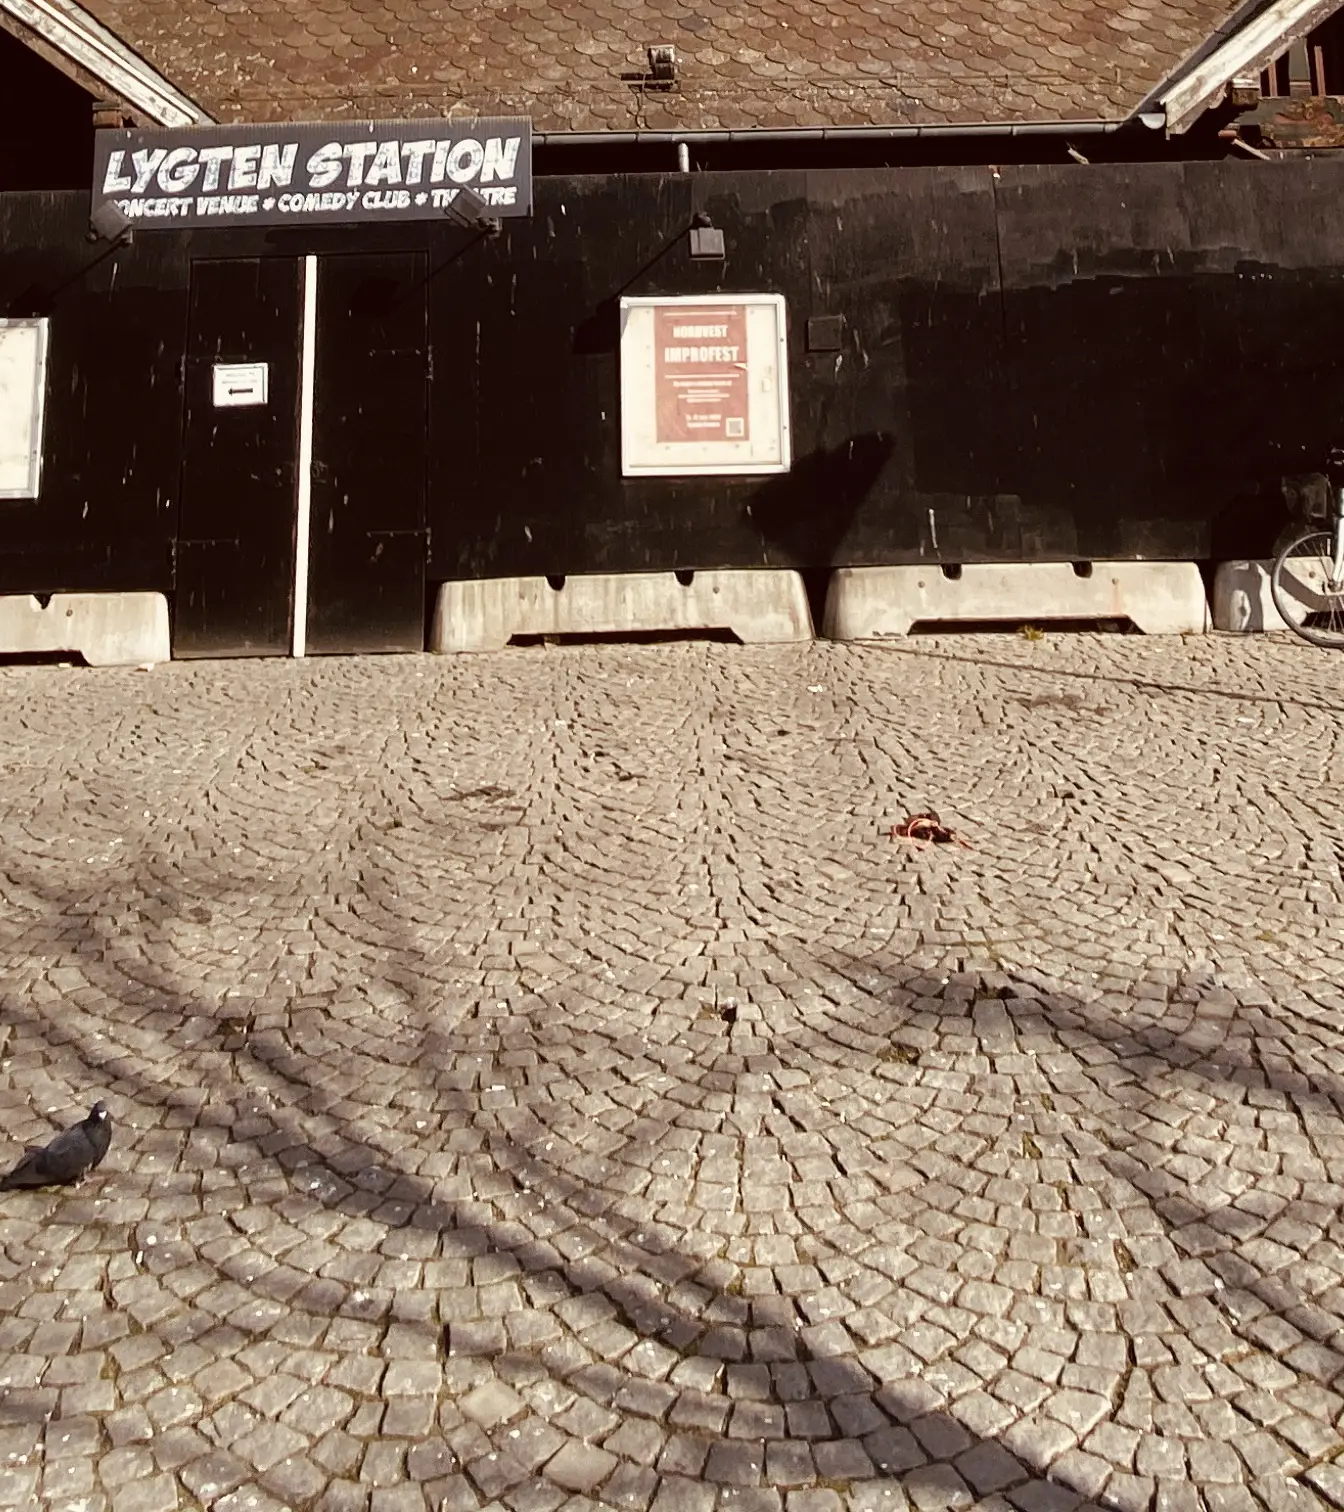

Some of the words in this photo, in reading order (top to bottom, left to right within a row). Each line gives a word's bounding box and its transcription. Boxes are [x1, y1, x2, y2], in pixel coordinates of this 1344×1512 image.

[102, 143, 299, 194] LYGTEN
[306, 137, 521, 188] STATION
[113, 195, 194, 218] ONCERT
[195, 194, 260, 216] VENUE
[277, 188, 361, 213] COMEDY
[362, 188, 411, 209] CLUB
[430, 186, 518, 208] THTRE
[664, 346, 740, 363] IMPROFEST
